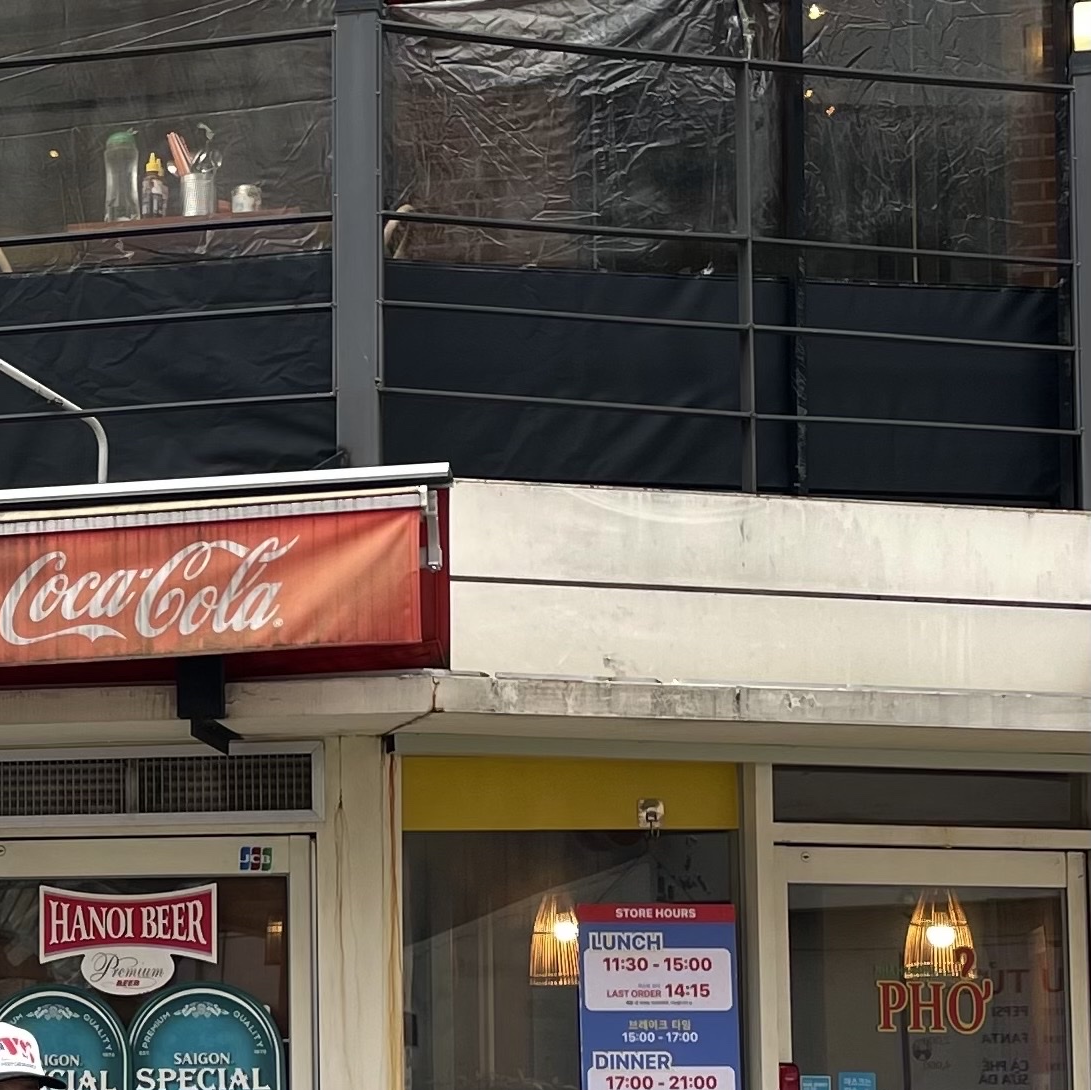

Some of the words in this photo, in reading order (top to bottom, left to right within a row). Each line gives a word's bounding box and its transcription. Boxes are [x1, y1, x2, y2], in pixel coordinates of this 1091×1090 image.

[0, 534, 300, 646] Coca-Cola
[616, 909, 653, 918] STORE
[656, 909, 696, 918] HOURS
[49, 900, 134, 945] HANOI
[141, 900, 207, 944] BEER
[590, 932, 663, 950] LUNCH
[90, 952, 164, 982] Premium
[603, 958, 648, 971] 11:30
[664, 958, 712, 971] 15:00
[607, 990, 629, 998] LAST
[631, 990, 661, 998] ORDER
[665, 983, 710, 998] 14:15
[877, 948, 993, 1034] PHỞ
[83, 1013, 112, 1050] QUALITY
[142, 1011, 170, 1049] PREMIUM
[233, 1010, 264, 1047] QUALITY
[629, 1019, 668, 1031] 브레이크
[672, 1019, 691, 1031] 타임
[622, 1032, 655, 1042] 15:00
[666, 1032, 698, 1042] 17:00
[42, 1054, 80, 1067] IGON
[173, 1052, 231, 1065] SAIGON
[594, 1052, 673, 1070] DINNER
[606, 1076, 653, 1090] 17:00
[669, 1075, 717, 1090] 21:00
